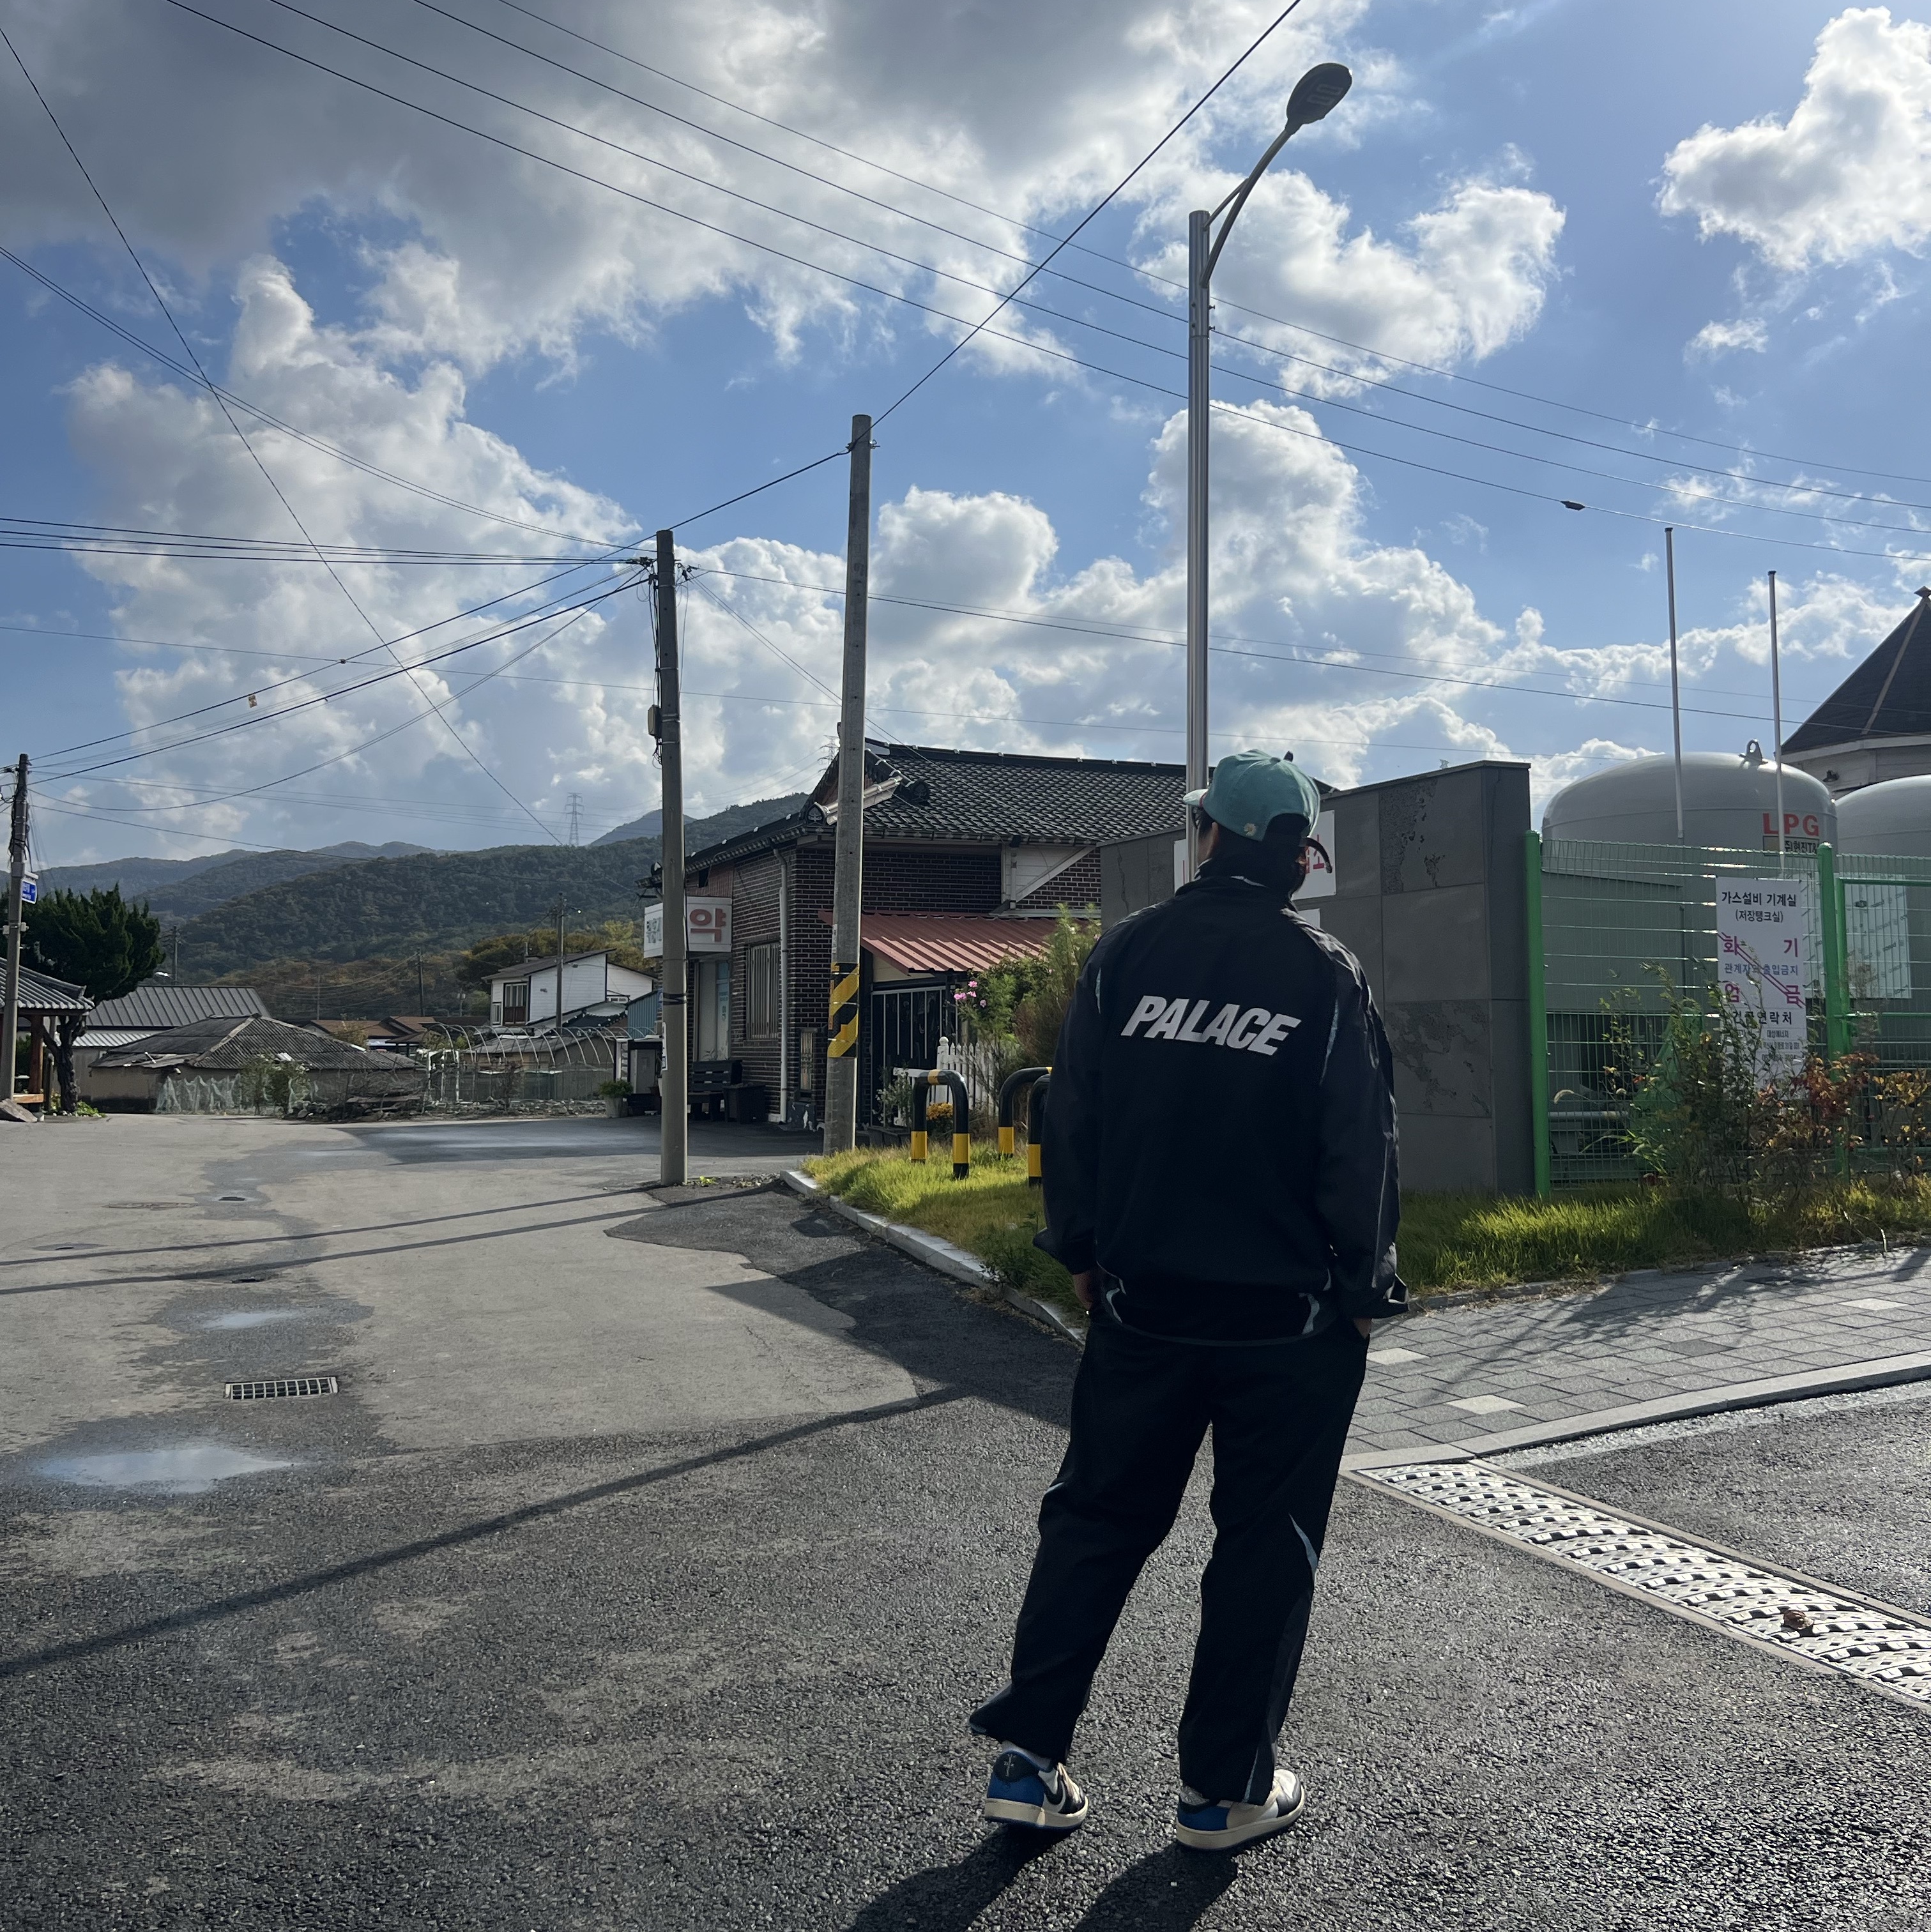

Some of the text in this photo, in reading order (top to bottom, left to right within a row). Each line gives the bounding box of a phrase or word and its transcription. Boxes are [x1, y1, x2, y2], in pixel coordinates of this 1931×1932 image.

[1763, 812, 1819, 836] LPG
[1721, 891, 1796, 907] 가스설비 기계실
[689, 908, 727, 942] 약
[1735, 908, 1783, 924] (저장탱크실)
[1723, 935, 1798, 957] 화 기
[1764, 964, 1798, 975] 출입금지
[1786, 985, 1800, 1004] 금
[1120, 995, 1302, 1056] PALACE
